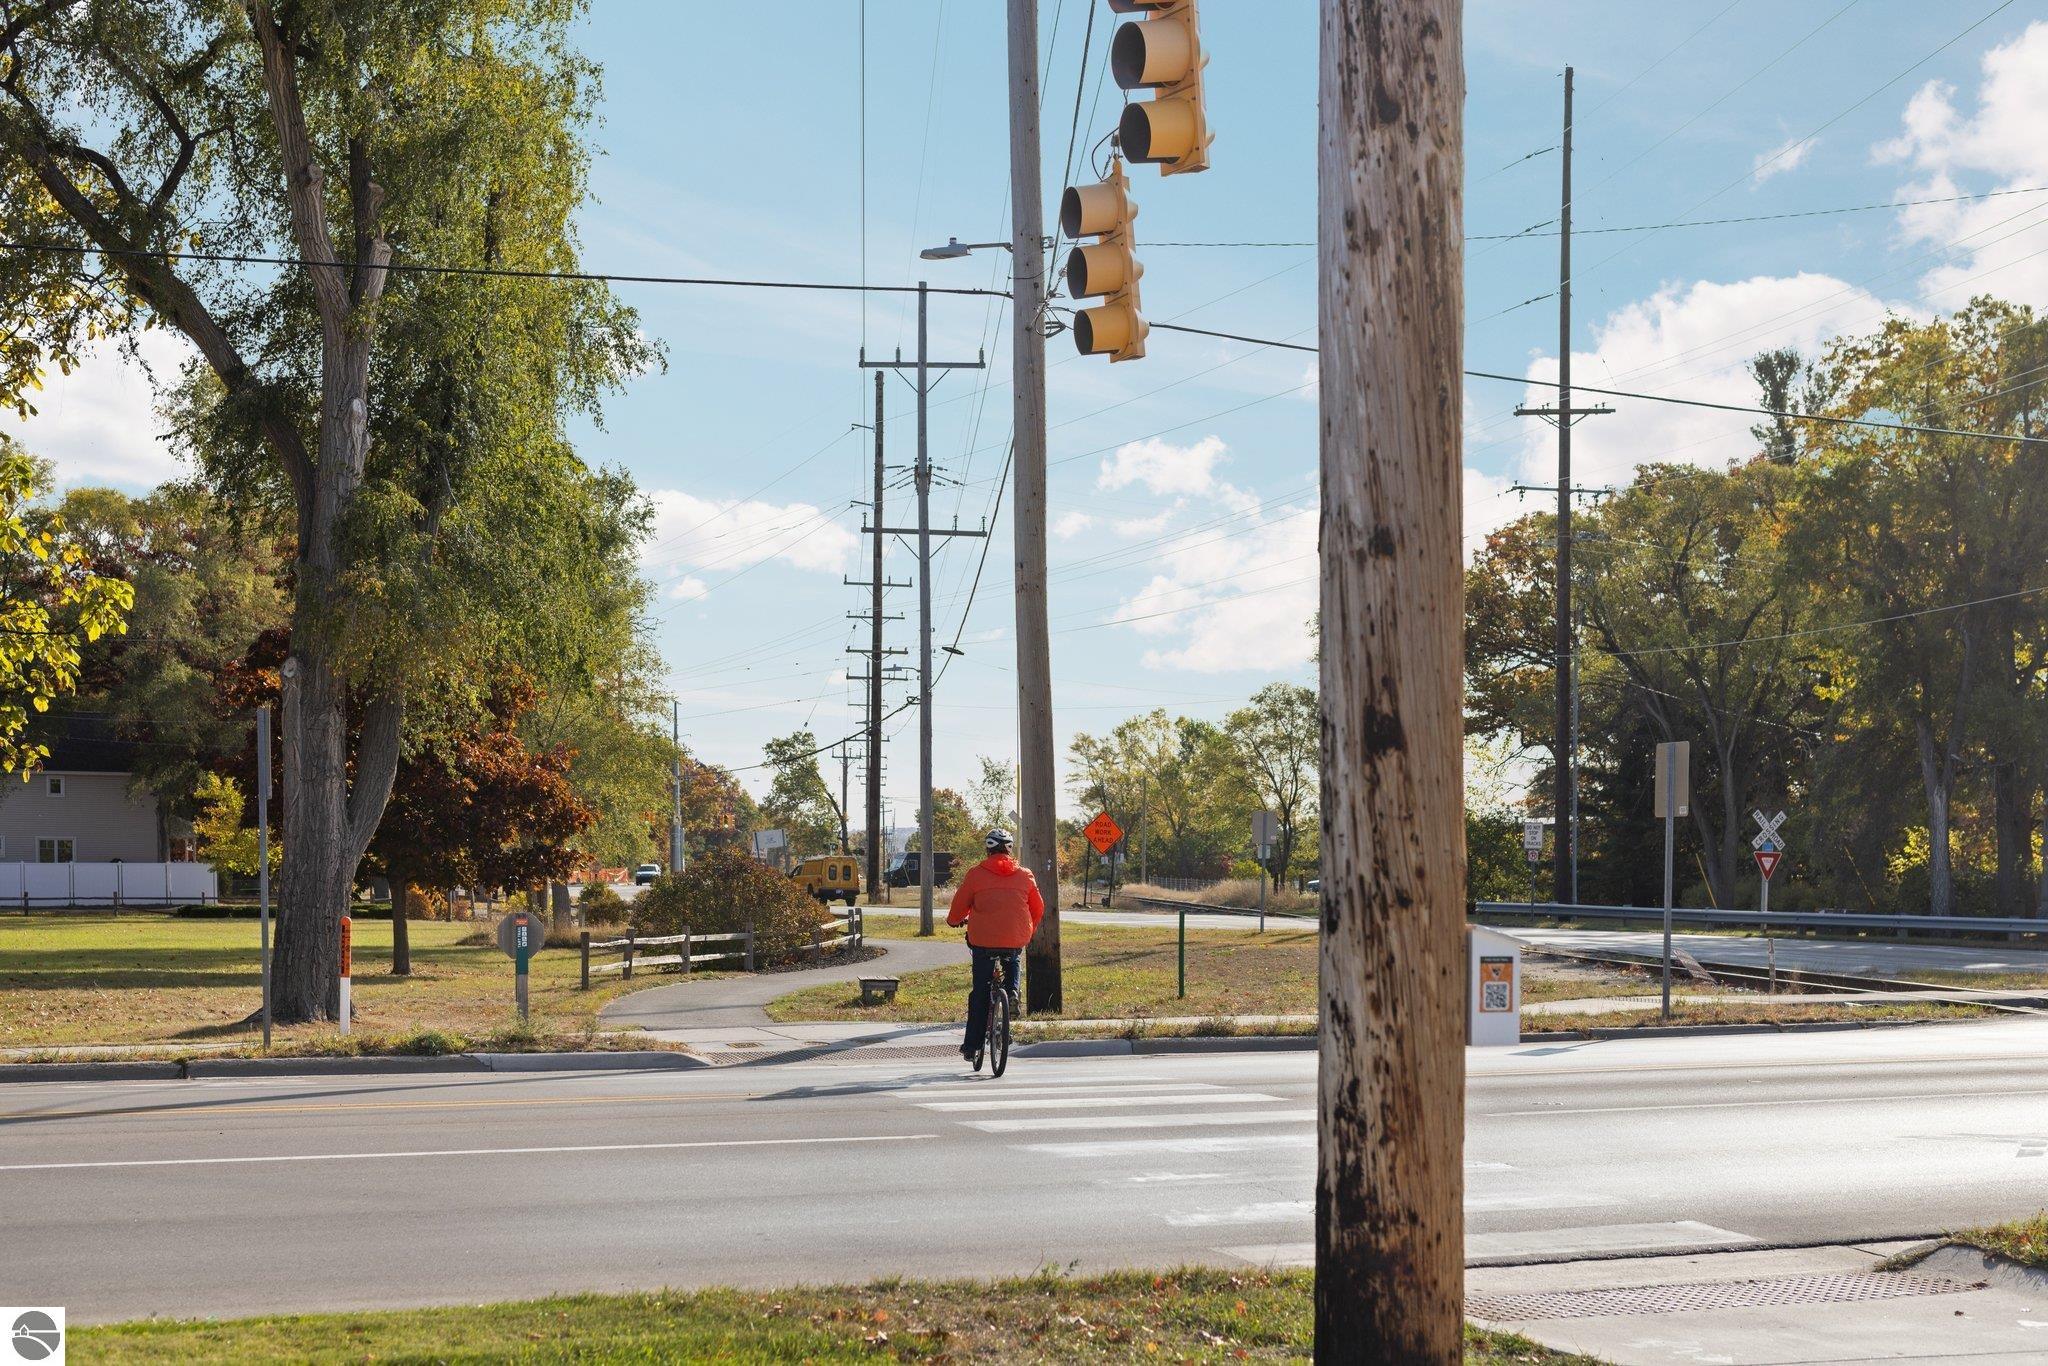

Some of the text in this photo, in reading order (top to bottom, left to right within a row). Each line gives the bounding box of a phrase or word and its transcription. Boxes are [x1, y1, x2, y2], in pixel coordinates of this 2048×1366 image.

[1754, 811, 1784, 849] RAIL ROAD
[1755, 814, 1784, 846] CROSSING
